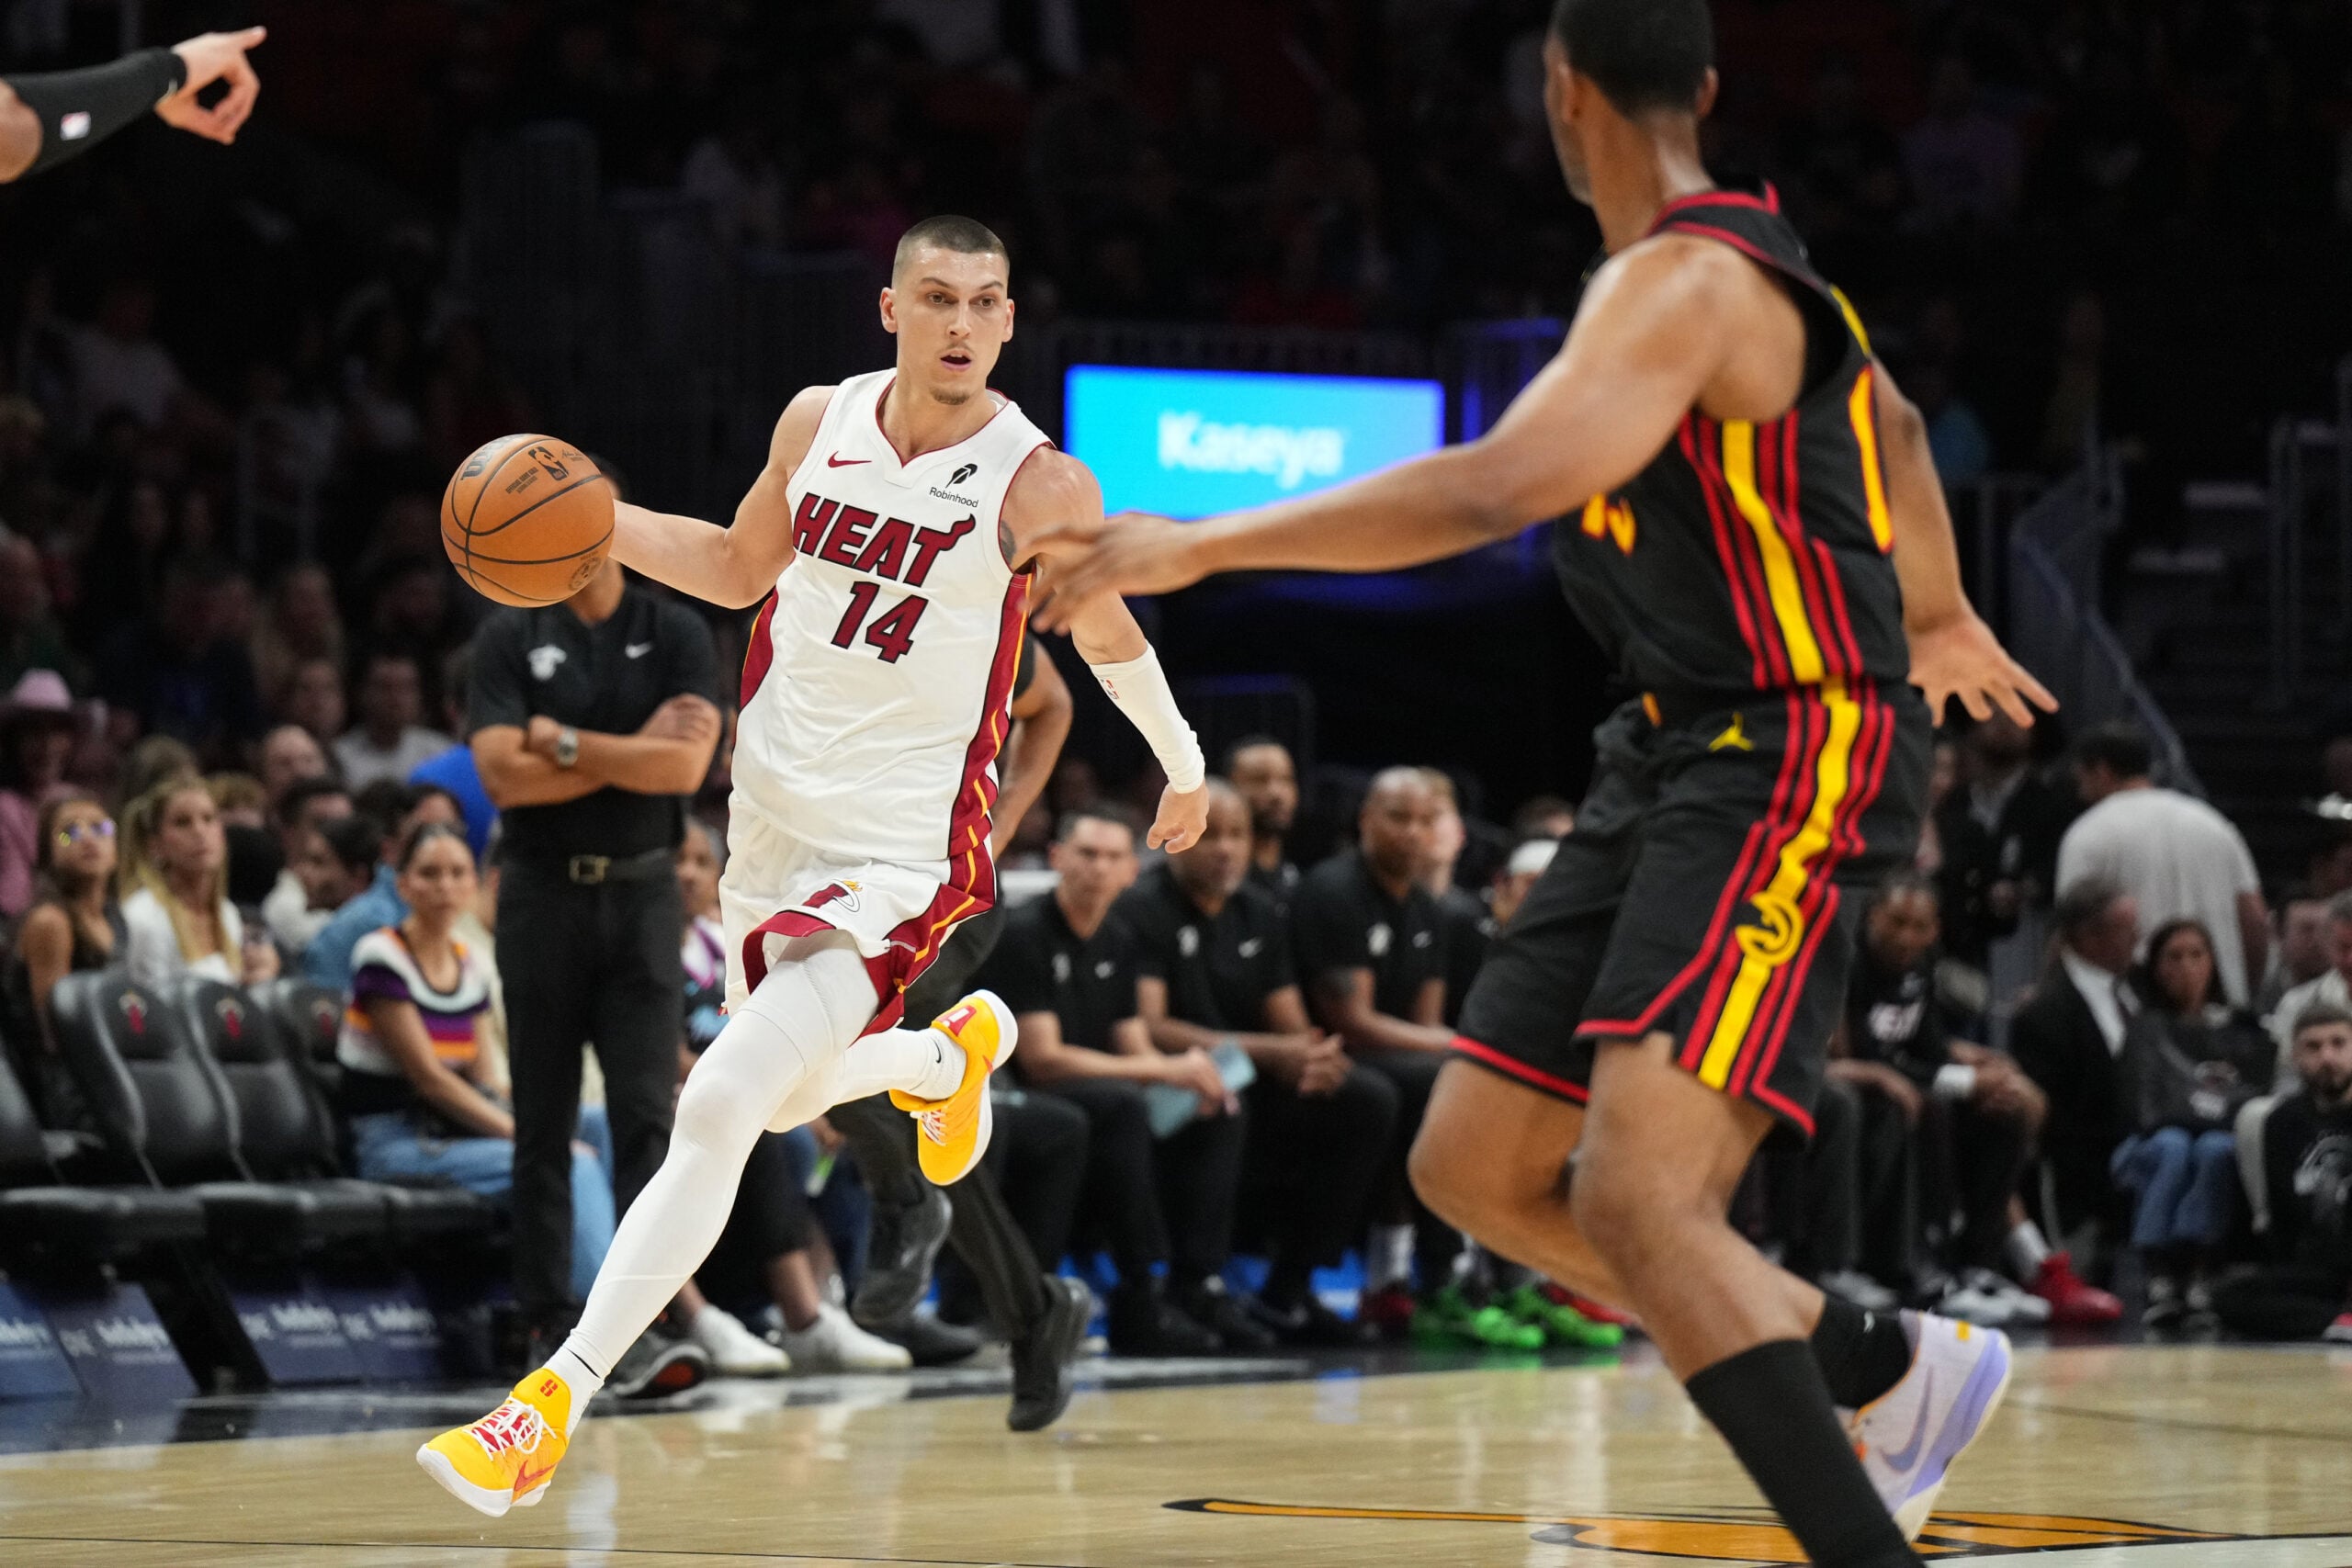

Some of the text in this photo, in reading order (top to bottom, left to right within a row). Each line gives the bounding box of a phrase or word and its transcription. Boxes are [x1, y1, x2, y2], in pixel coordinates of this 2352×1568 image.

[1159, 411, 1343, 489] Kaseya
[929, 486, 979, 508] Robinhood
[792, 491, 977, 588] HEAT
[831, 581, 929, 664] 14
